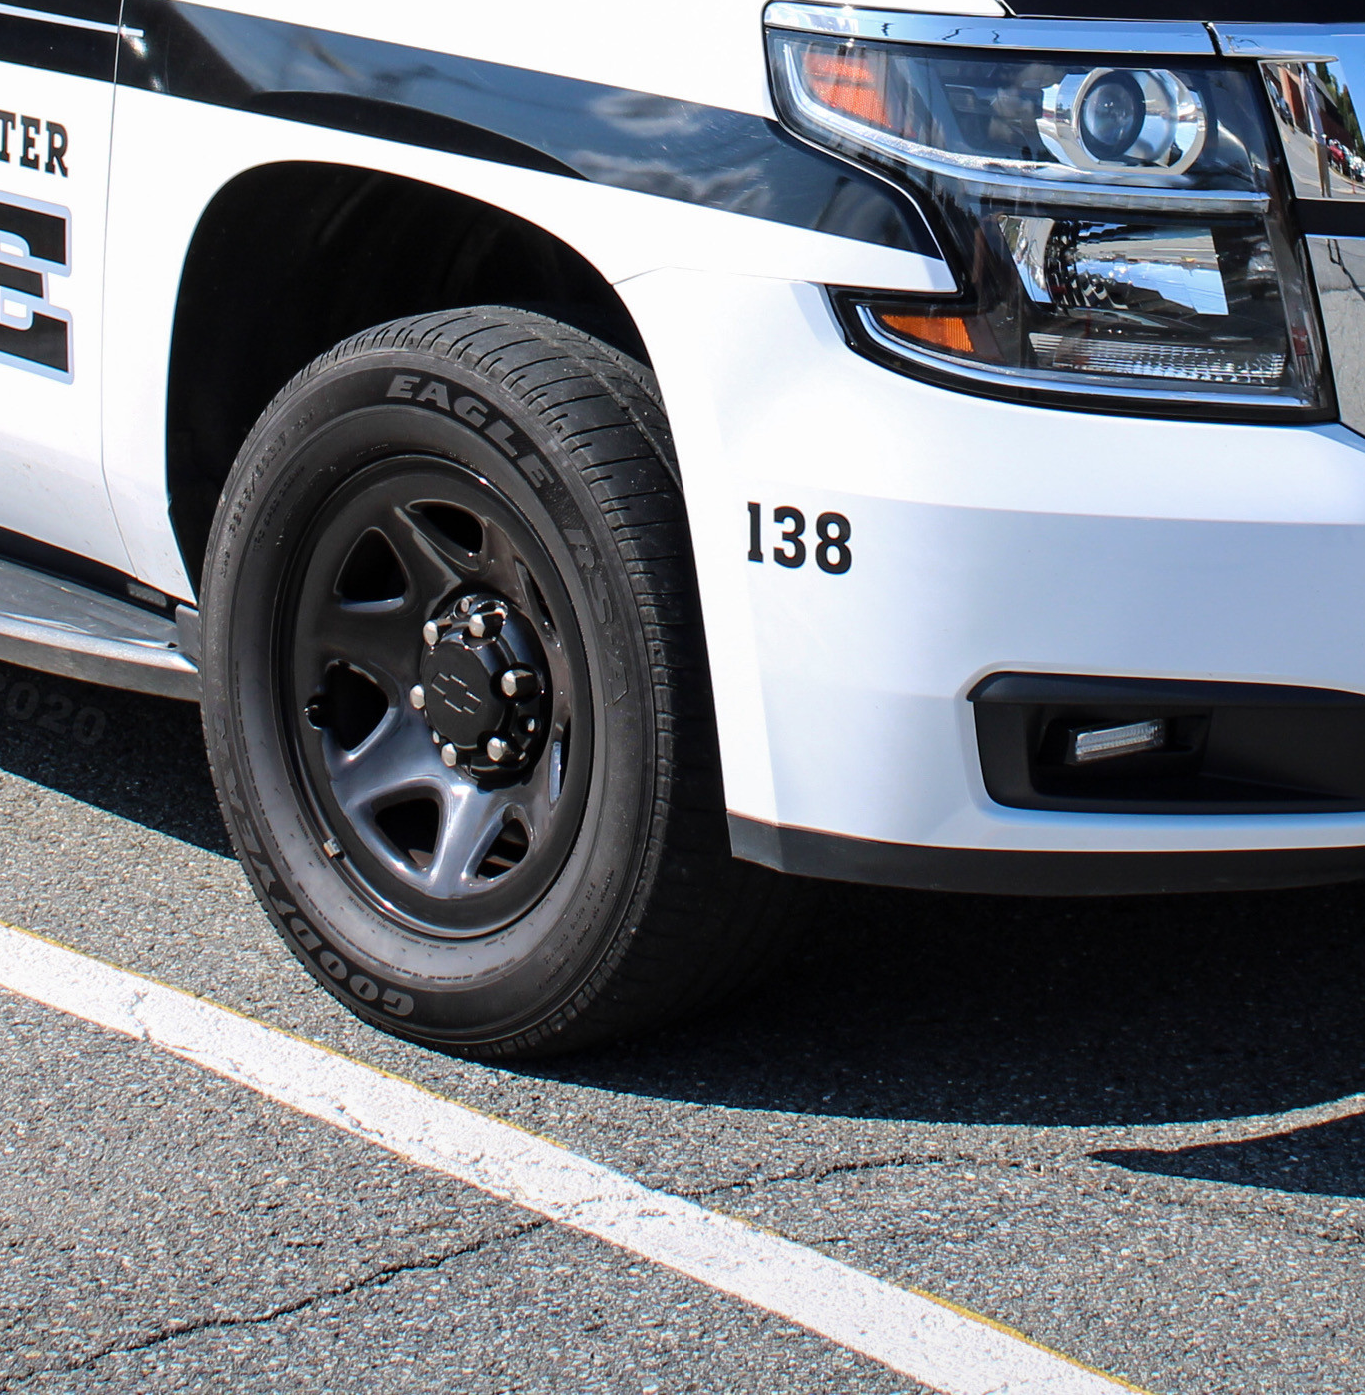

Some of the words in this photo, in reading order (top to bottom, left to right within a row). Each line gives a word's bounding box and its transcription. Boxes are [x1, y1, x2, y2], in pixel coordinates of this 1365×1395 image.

[386, 374, 555, 489] EAGLE
[747, 501, 852, 575] 138
[212, 716, 415, 1017] GOODYEAR
